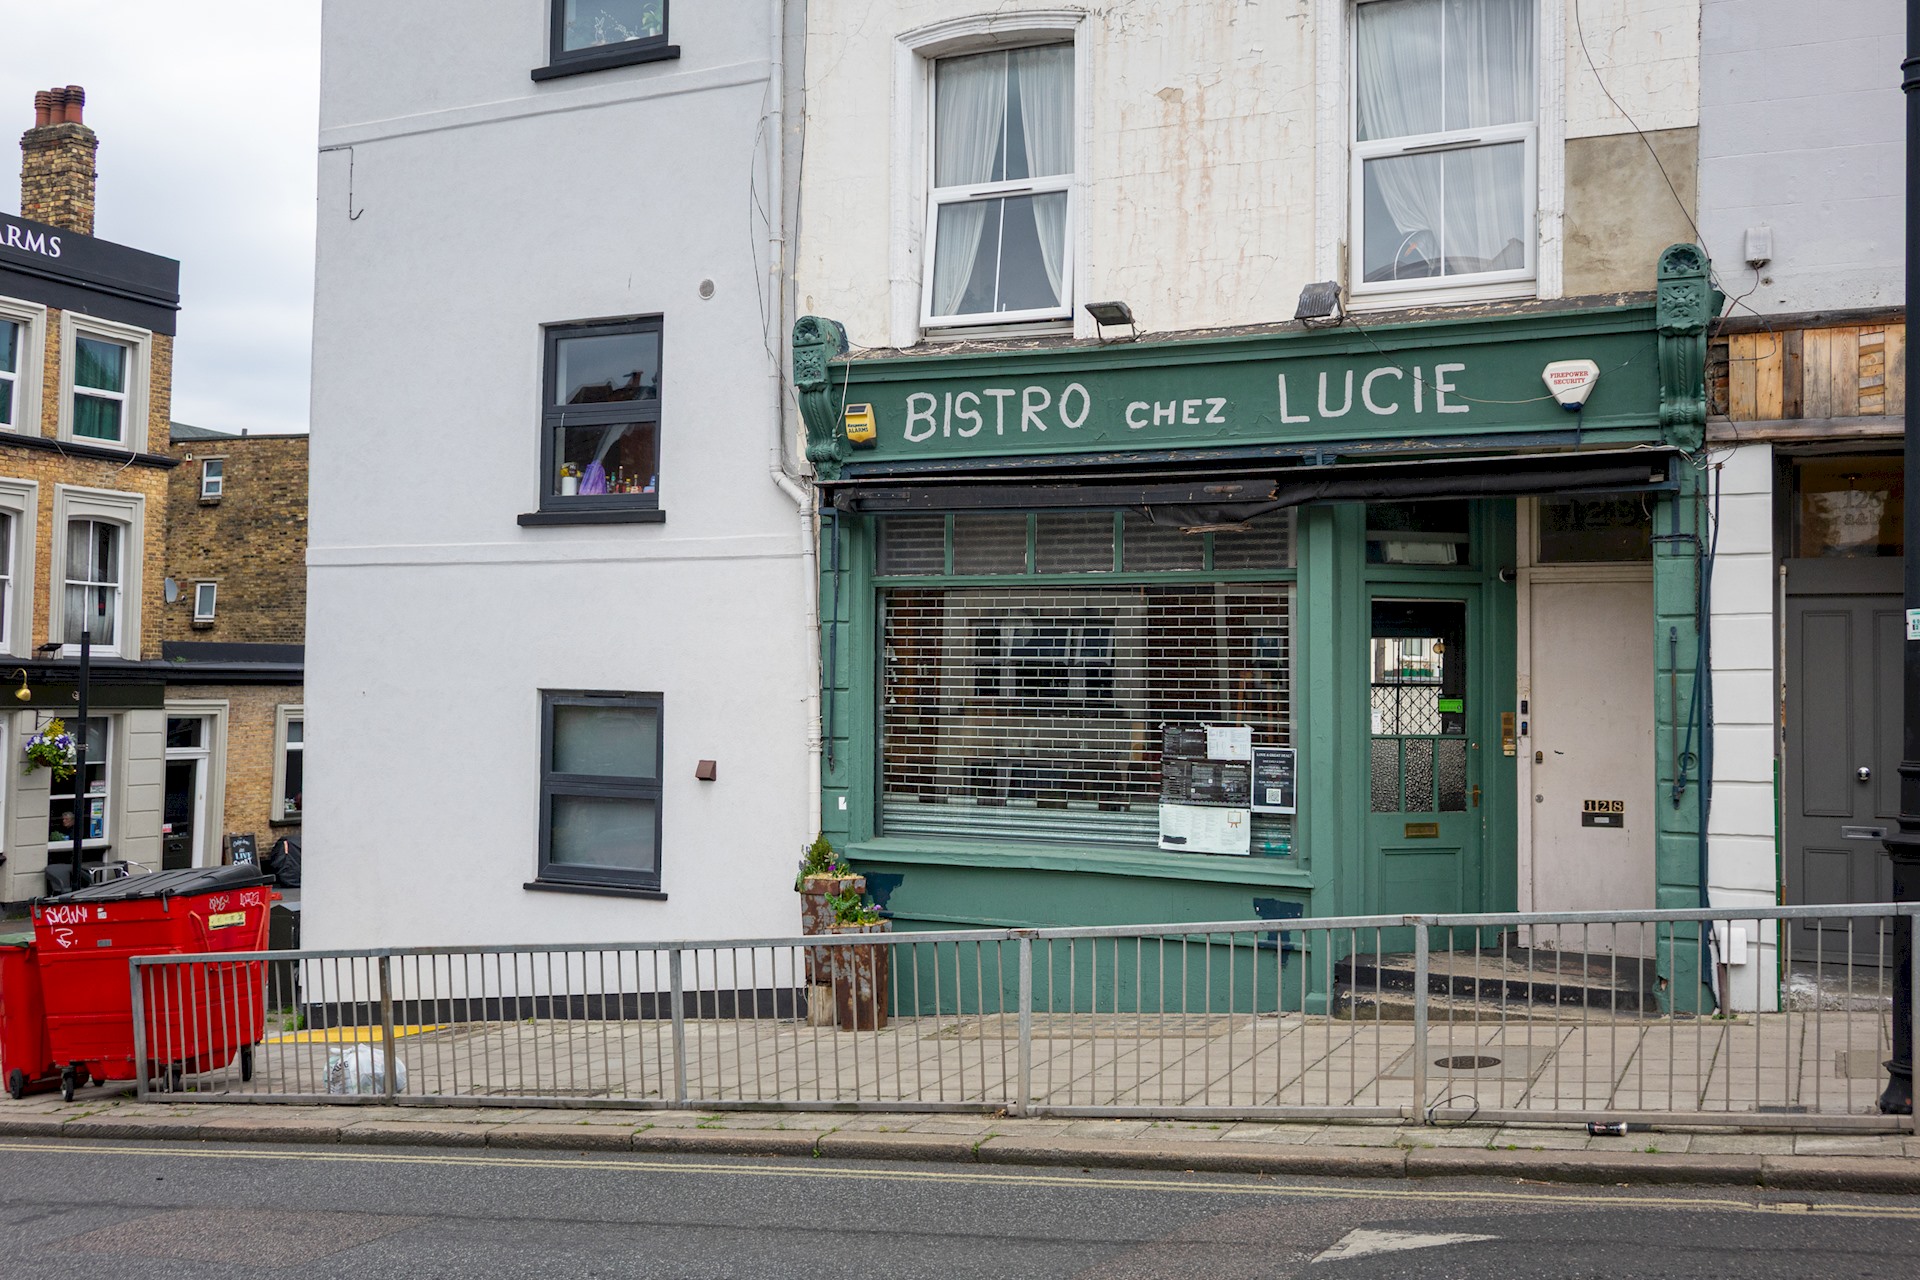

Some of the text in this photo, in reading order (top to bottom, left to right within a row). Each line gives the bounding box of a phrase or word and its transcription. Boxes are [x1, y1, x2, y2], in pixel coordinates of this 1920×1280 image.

[1550, 371, 1589, 379] FIREPOWER
[904, 364, 1469, 442] BISTRO CHEZ LUCIE
[1585, 800, 1623, 811] 128
